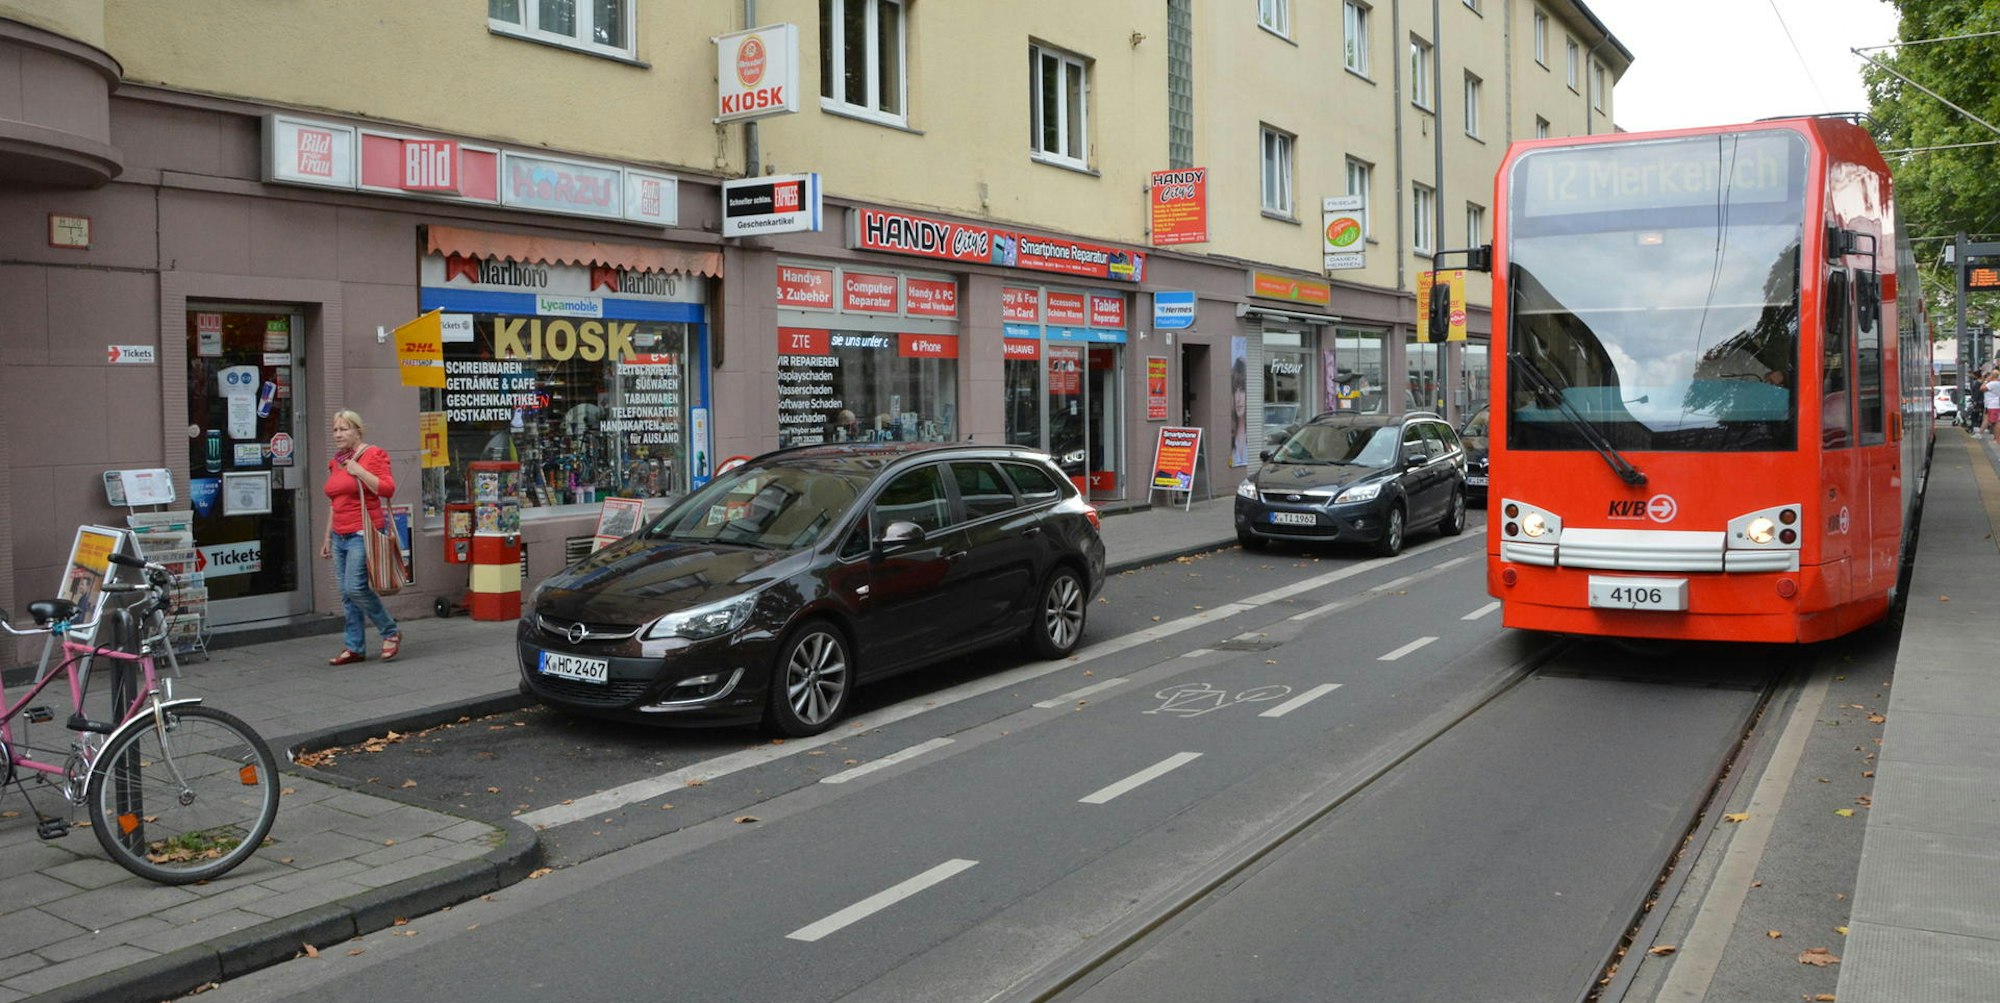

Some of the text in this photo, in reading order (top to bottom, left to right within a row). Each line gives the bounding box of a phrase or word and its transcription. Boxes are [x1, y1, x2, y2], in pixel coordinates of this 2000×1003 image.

[722, 86, 783, 114] KIOSK
[300, 132, 330, 154] Bild
[300, 153, 330, 174] Frau
[405, 143, 450, 188] Bild
[1153, 170, 1204, 186] HANDY
[1546, 159, 1578, 200] 12
[729, 198, 752, 206] Schneller
[774, 186, 798, 208] EXPRESS
[738, 216, 794, 229] Geschenkartikel
[866, 212, 950, 254] HANDY
[1021, 237, 1108, 264] Smartphone Reparatur
[478, 258, 548, 288] Marlboro
[783, 270, 822, 285] Handys
[617, 268, 676, 296] Marlboro
[846, 280, 893, 294] Computer
[786, 288, 829, 302] Zubehör
[908, 287, 953, 300] Handy & PC
[1002, 293, 1038, 304] opy & Fax
[541, 298, 598, 312] Lycamobile
[850, 295, 890, 308] Reparatur
[932, 302, 955, 311] Verkauf
[1094, 299, 1120, 313] Tablet
[1016, 306, 1034, 318] Card
[1094, 313, 1120, 324] Reparatur
[440, 321, 460, 330] ickets
[404, 342, 436, 352] DHL
[494, 318, 638, 362] KIOSK
[792, 334, 810, 349] ZTE
[831, 333, 844, 346] sie
[845, 336, 861, 347] uns
[919, 341, 942, 352] iPhone
[1008, 345, 1034, 354] HUAWEI
[446, 361, 522, 374] SCHREIBWAREN
[790, 357, 839, 368] REPARIEREN
[1271, 358, 1303, 374] Friseur
[446, 376, 536, 390] GETRÄNKE & CAFE
[446, 394, 540, 407] GESCHENKARTIKEL
[624, 393, 678, 404] TABAKWAREN
[811, 398, 842, 408] Schaden
[448, 408, 512, 422] POSTKARTEN
[612, 406, 678, 418] TELEFONKARTEN
[630, 432, 679, 444] für AUSLAND
[1163, 430, 1196, 438] Smartphone
[1165, 439, 1192, 447] Reparatur
[1608, 501, 1646, 516] KVB
[1295, 515, 1314, 524] 1962
[212, 548, 261, 566] Tickets
[1610, 587, 1662, 603] 4106
[545, 655, 606, 678] K HC 2467
